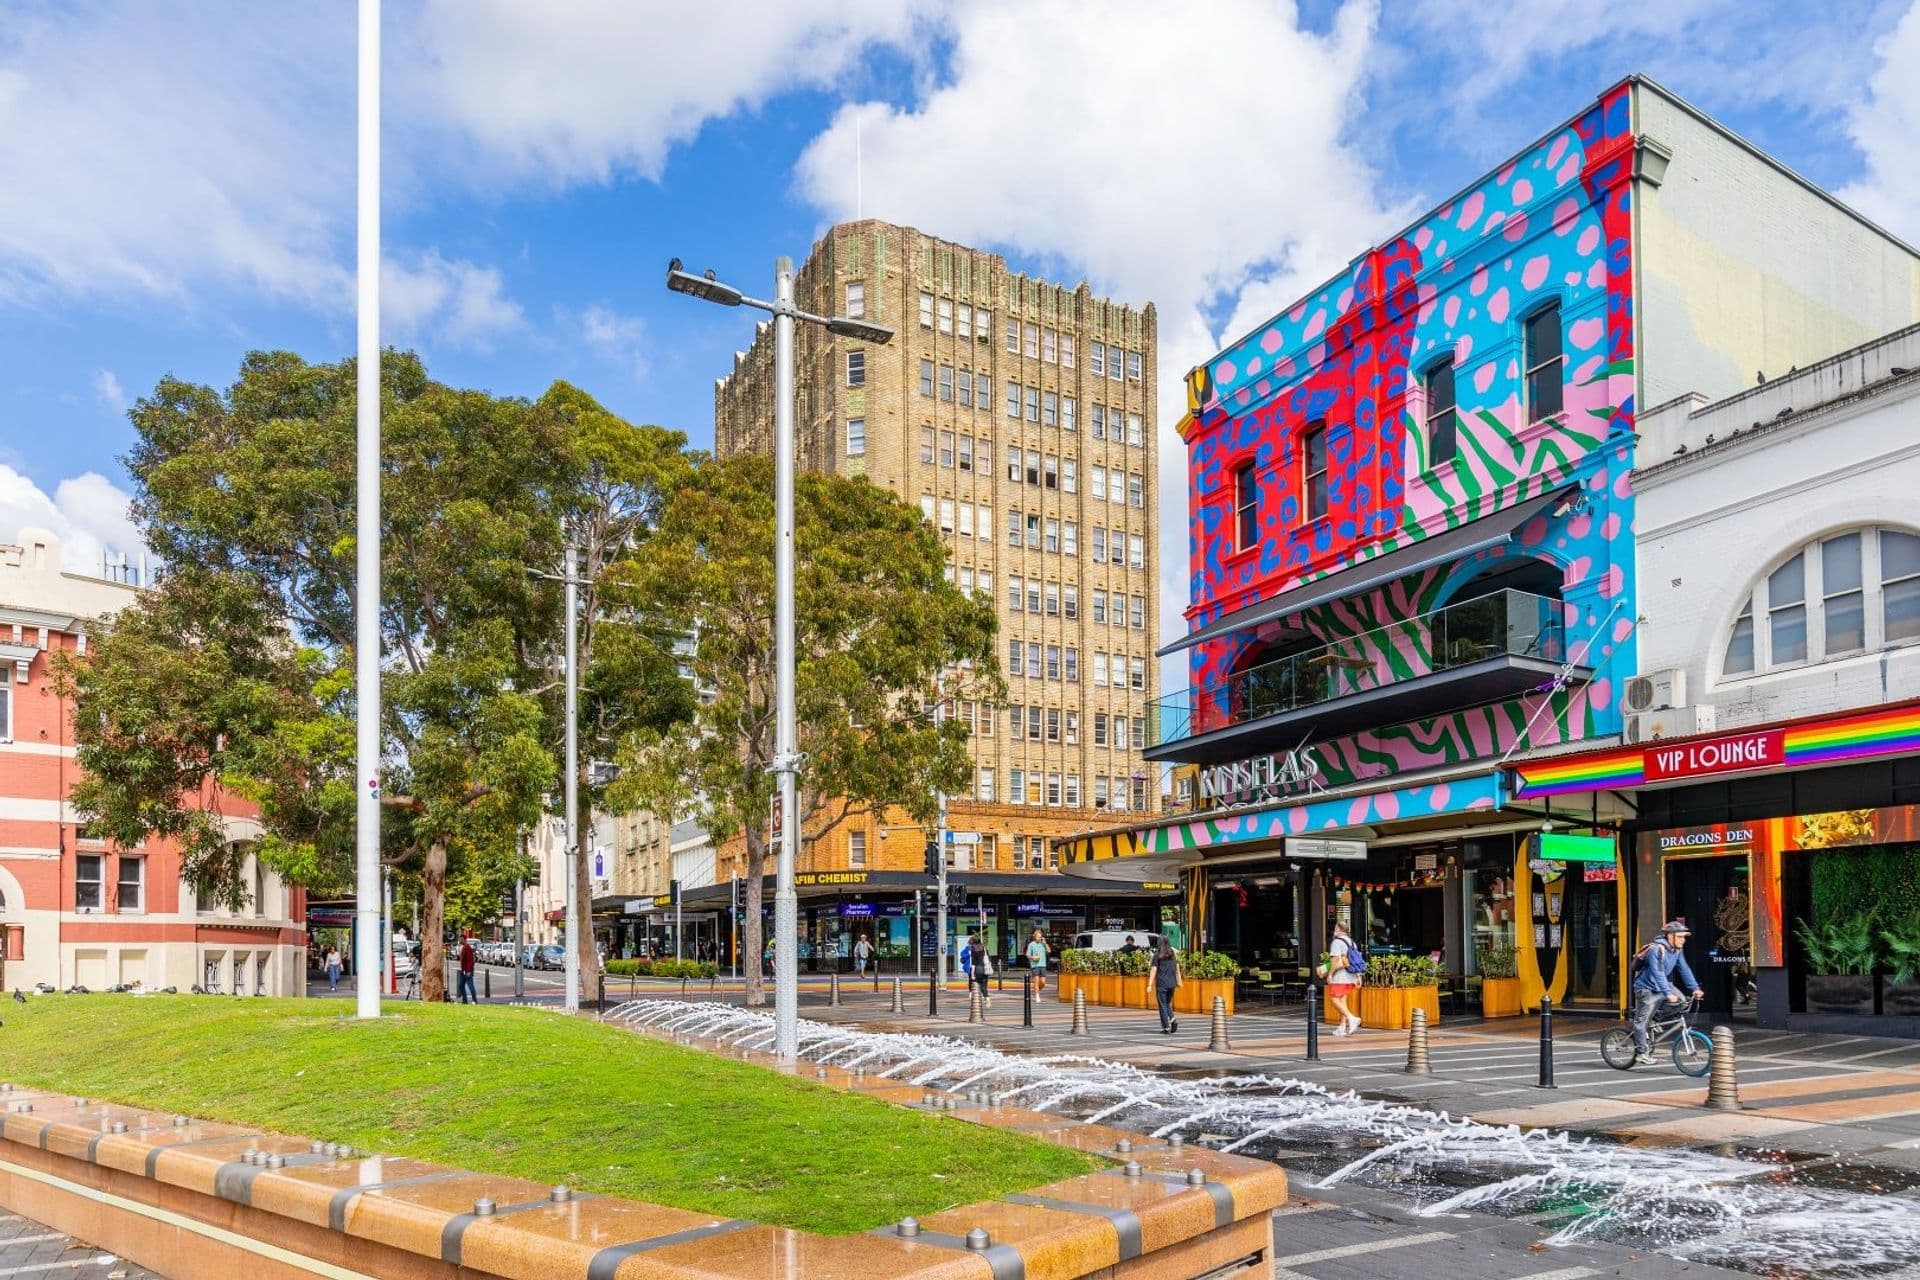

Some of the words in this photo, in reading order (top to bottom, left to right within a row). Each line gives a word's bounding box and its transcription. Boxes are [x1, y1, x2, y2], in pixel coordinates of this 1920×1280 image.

[1657, 751, 1684, 772] VIP
[1690, 738, 1767, 767] LOUNGE
[1661, 832, 1721, 847] DRAGONS
[1726, 830, 1753, 842] DEN
[795, 875, 815, 885] AFIM
[818, 873, 867, 884] CHEMIST
